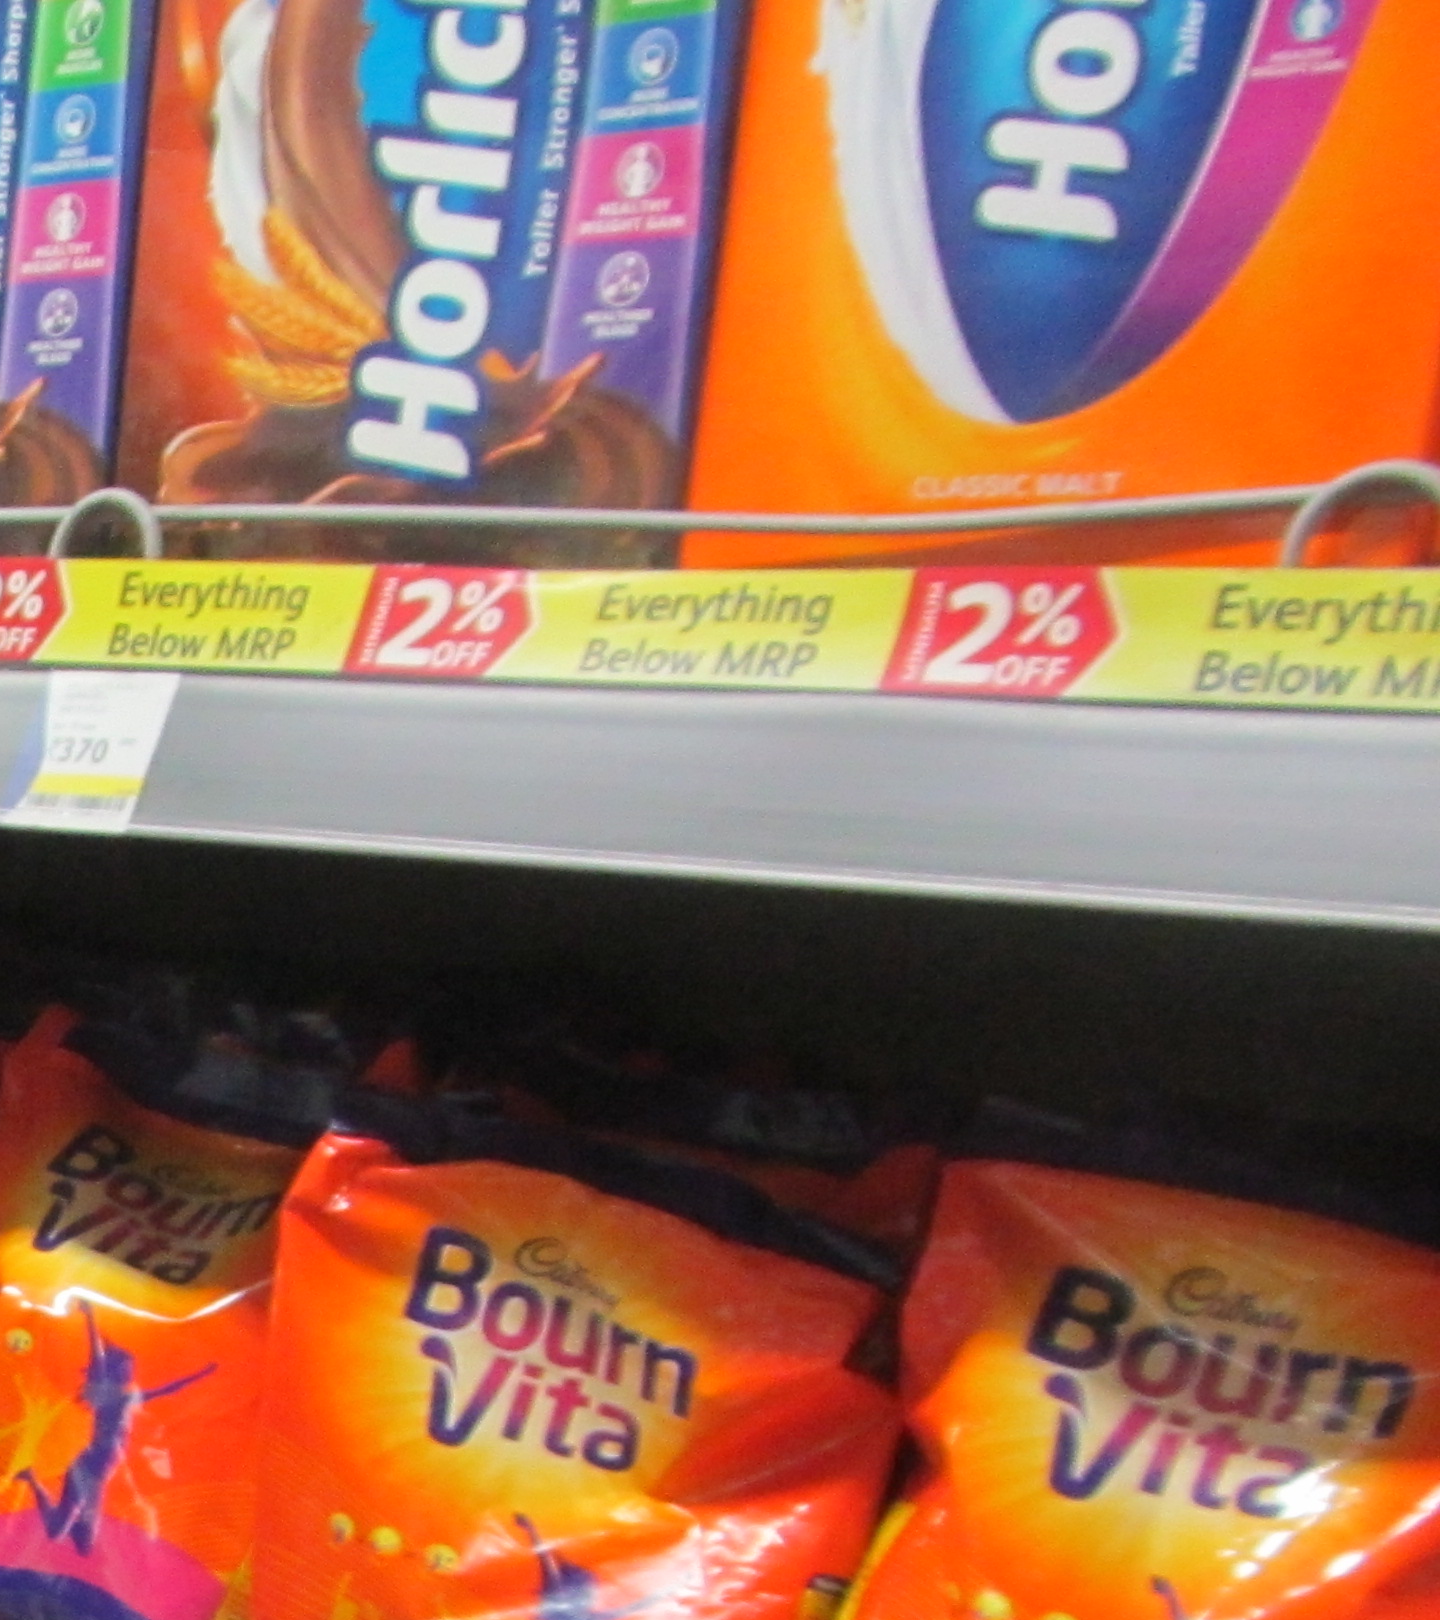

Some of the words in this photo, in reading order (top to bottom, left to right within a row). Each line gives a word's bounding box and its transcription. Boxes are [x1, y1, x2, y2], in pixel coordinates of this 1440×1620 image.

[975, 0, 1142, 242] Ho
[347, 0, 527, 478] Horlic
[523, 187, 562, 278] Taller
[913, 474, 1029, 499] CLASSIC
[1037, 471, 1124, 495] MALT
[106, 623, 203, 660] Below
[117, 573, 312, 622] Everything
[376, 577, 515, 669] 2%
[596, 583, 837, 632] Everything
[923, 581, 1086, 685] 2%
[431, 639, 495, 670] OFF
[578, 639, 711, 677] Below
[990, 654, 1075, 688] OFF
[1193, 650, 1360, 697] Below
[47, 1122, 276, 1234] Bourn
[32, 1180, 213, 1286] Vita
[404, 1226, 700, 1419] Bourn
[1026, 1264, 1414, 1441] Bourn
[419, 1334, 641, 1473] Vita
[1044, 1372, 1325, 1520] Vita
